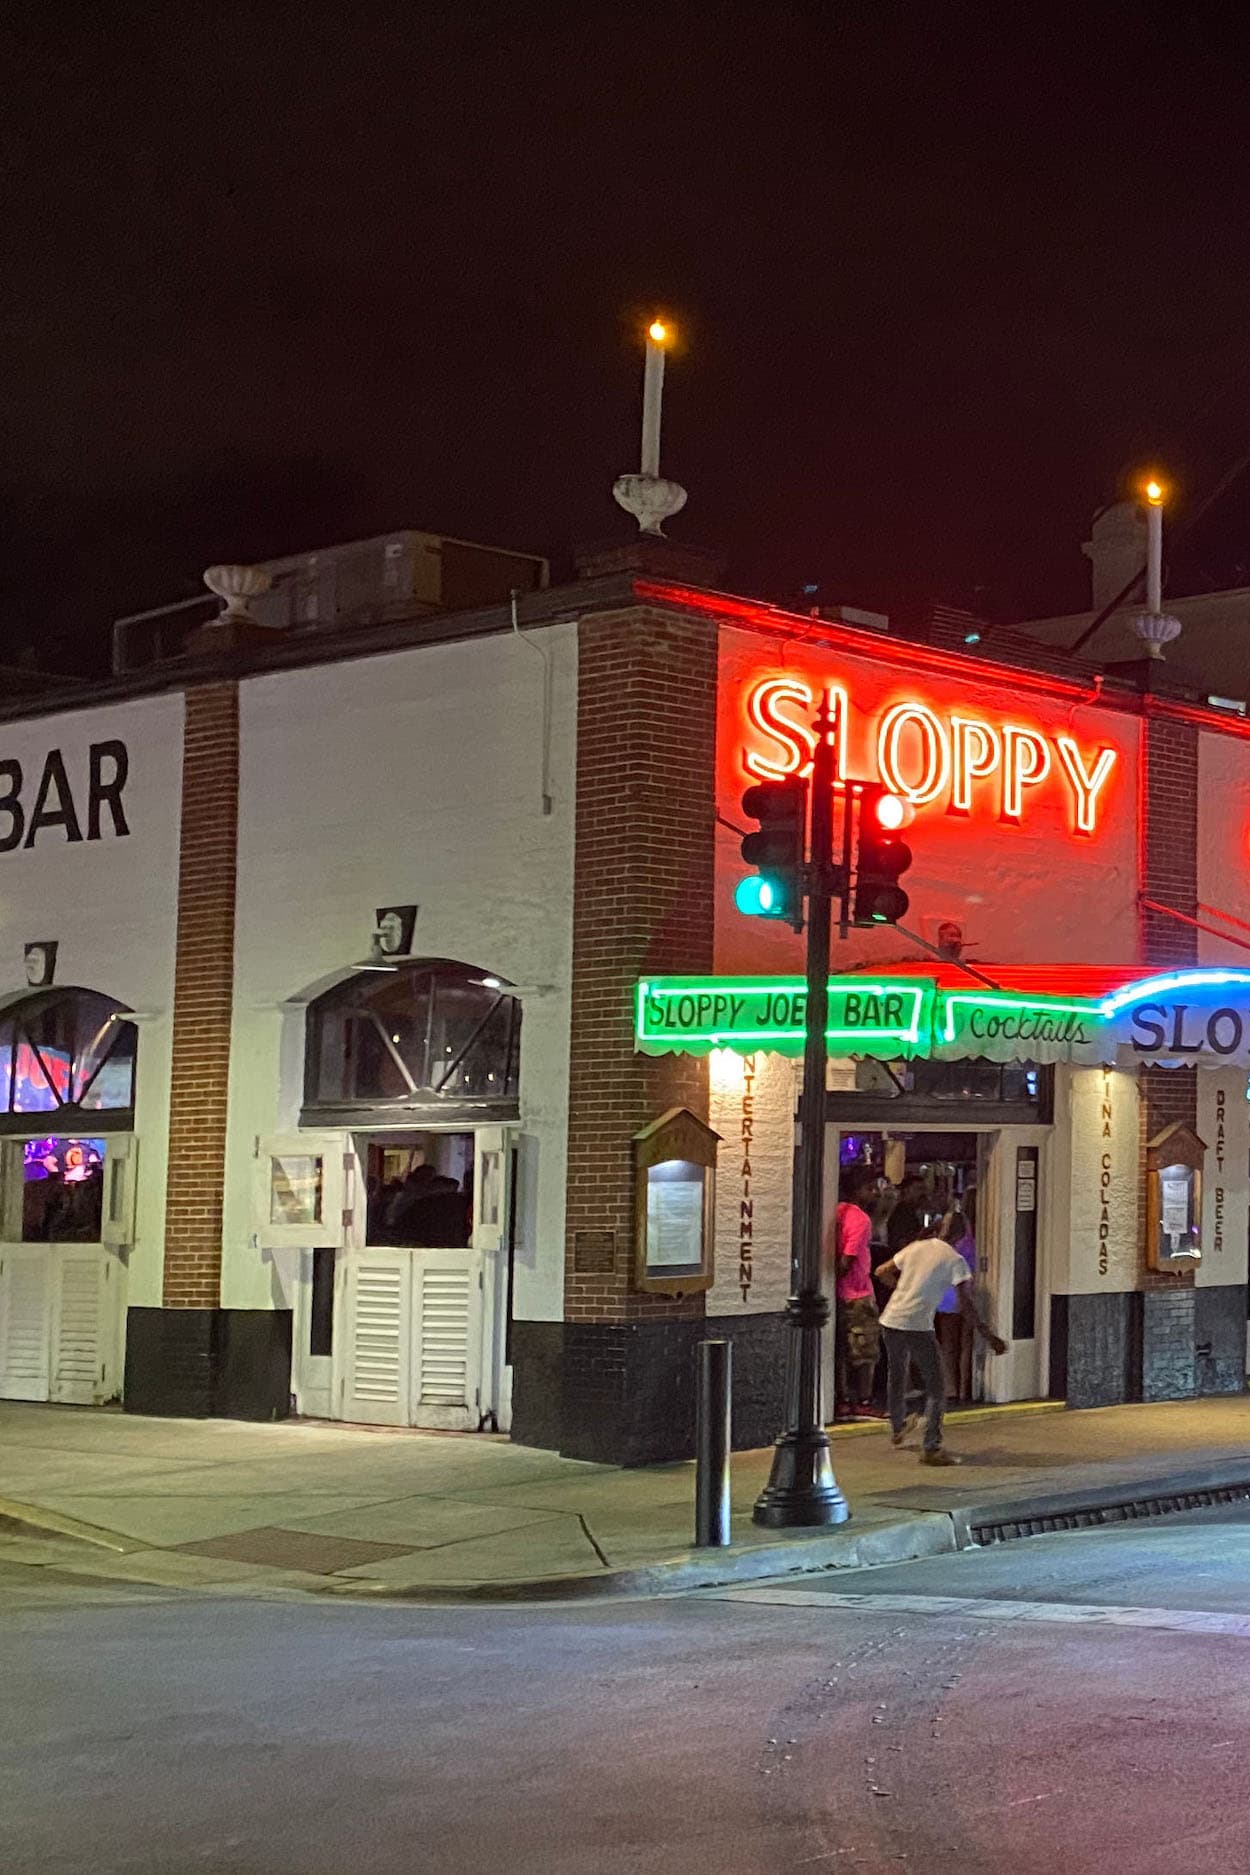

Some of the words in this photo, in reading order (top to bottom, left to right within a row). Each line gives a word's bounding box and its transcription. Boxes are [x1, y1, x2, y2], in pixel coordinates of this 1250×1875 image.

[0, 739, 130, 852] BAR
[649, 993, 745, 1029] SLOPPY
[756, 993, 806, 1026] JOE
[843, 993, 904, 1026] BAR
[971, 1008, 1092, 1044] Cocktails
[1215, 1089, 1225, 1173] DRAFT
[739, 1055, 755, 1303] NTERTAINMENT
[1098, 1153, 1111, 1276] COLADAS
[1213, 1187, 1224, 1252] BEER
